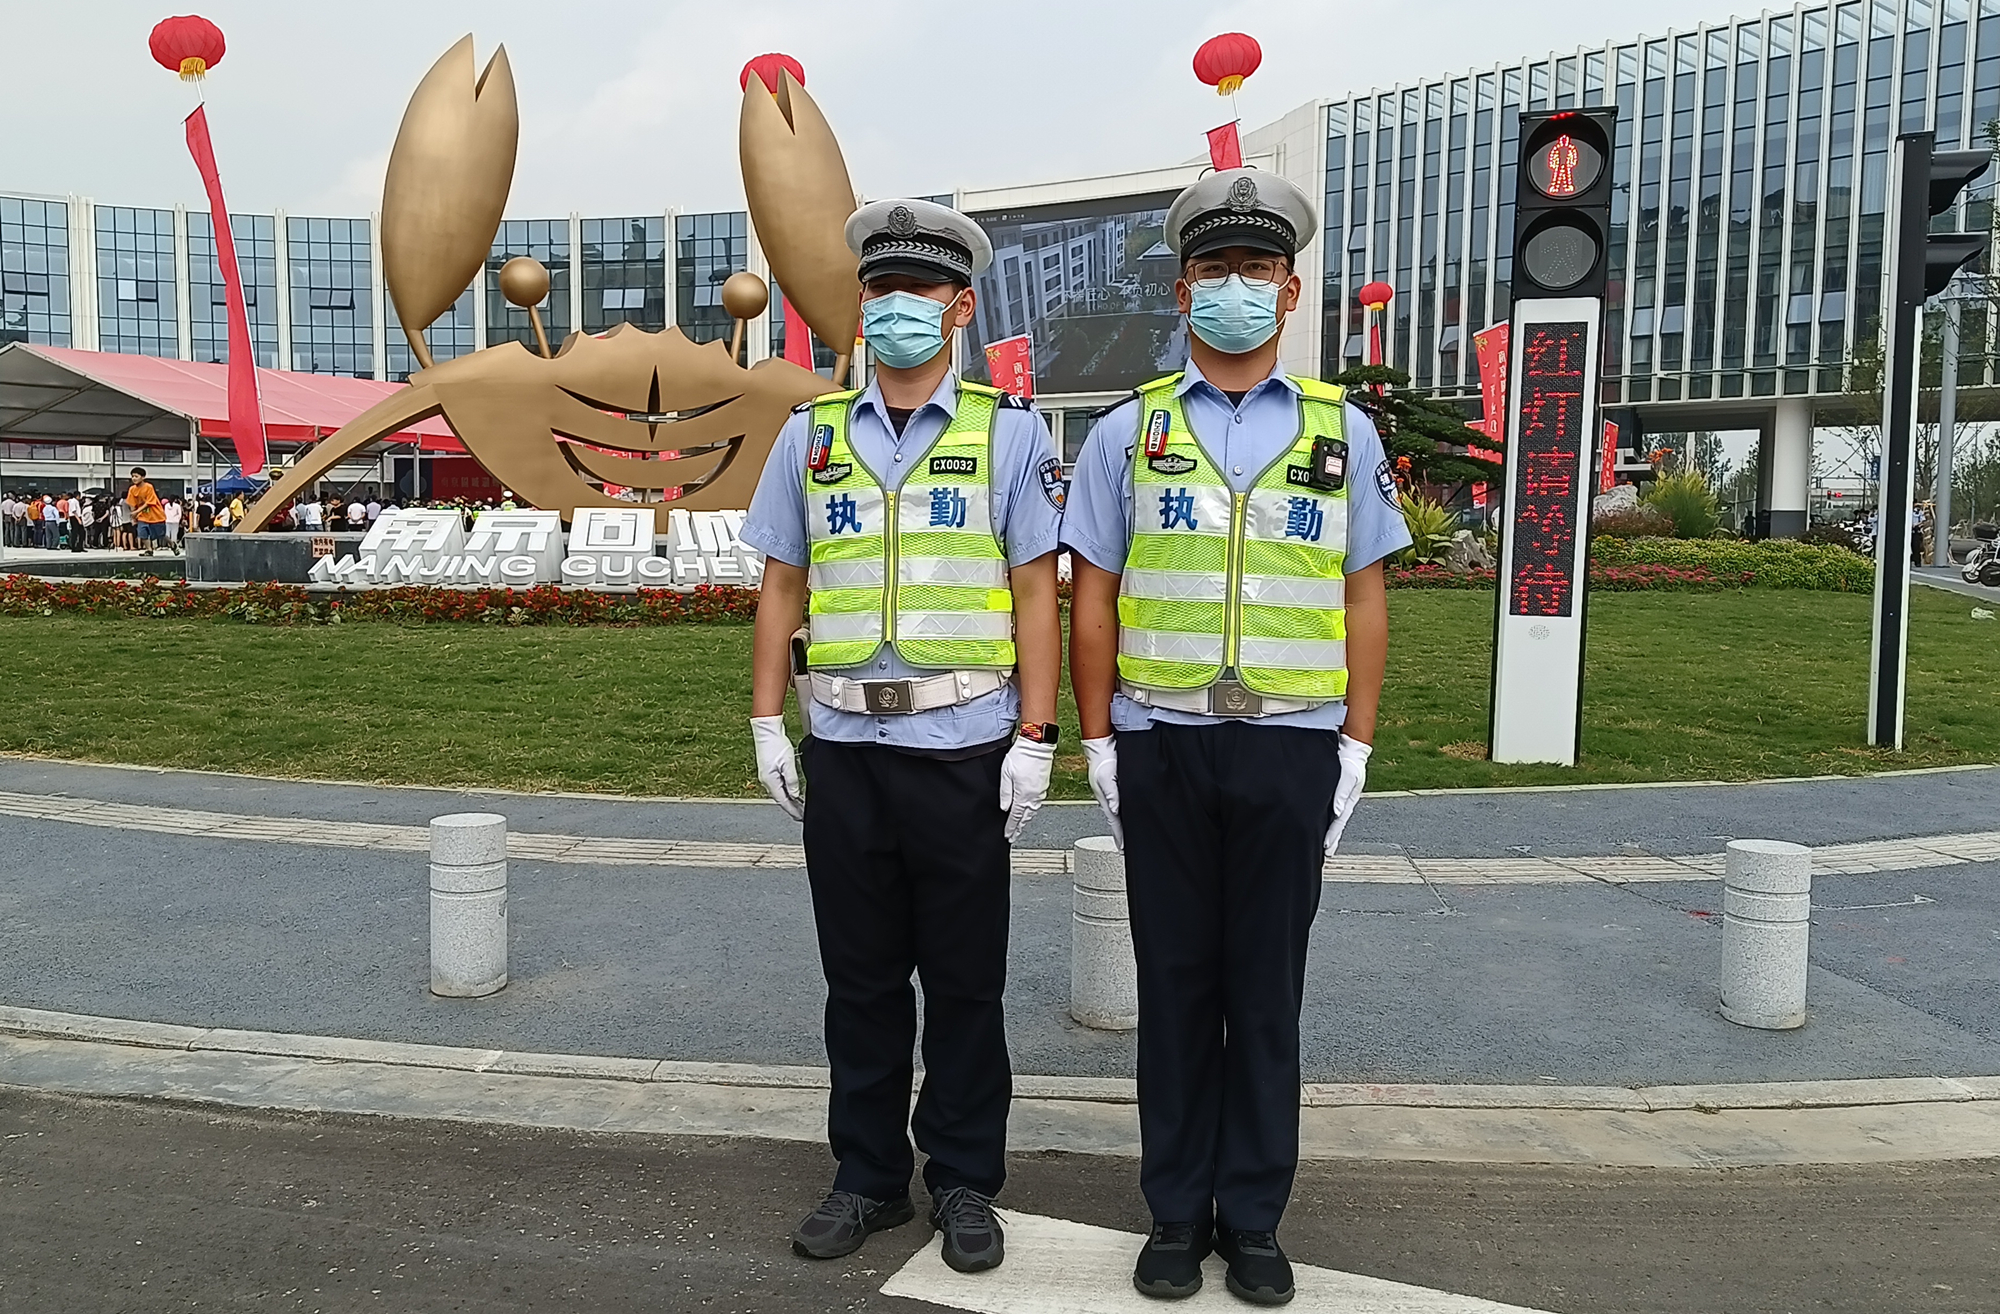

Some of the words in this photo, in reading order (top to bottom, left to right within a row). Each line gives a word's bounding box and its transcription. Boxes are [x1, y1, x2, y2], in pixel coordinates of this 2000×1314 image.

[933, 458, 974, 471] CX0032
[825, 493, 862, 535] 执
[928, 487, 967, 529] 勤
[1158, 487, 1199, 531] 执
[1284, 495, 1324, 542] 勤
[307, 553, 537, 578] NANJING
